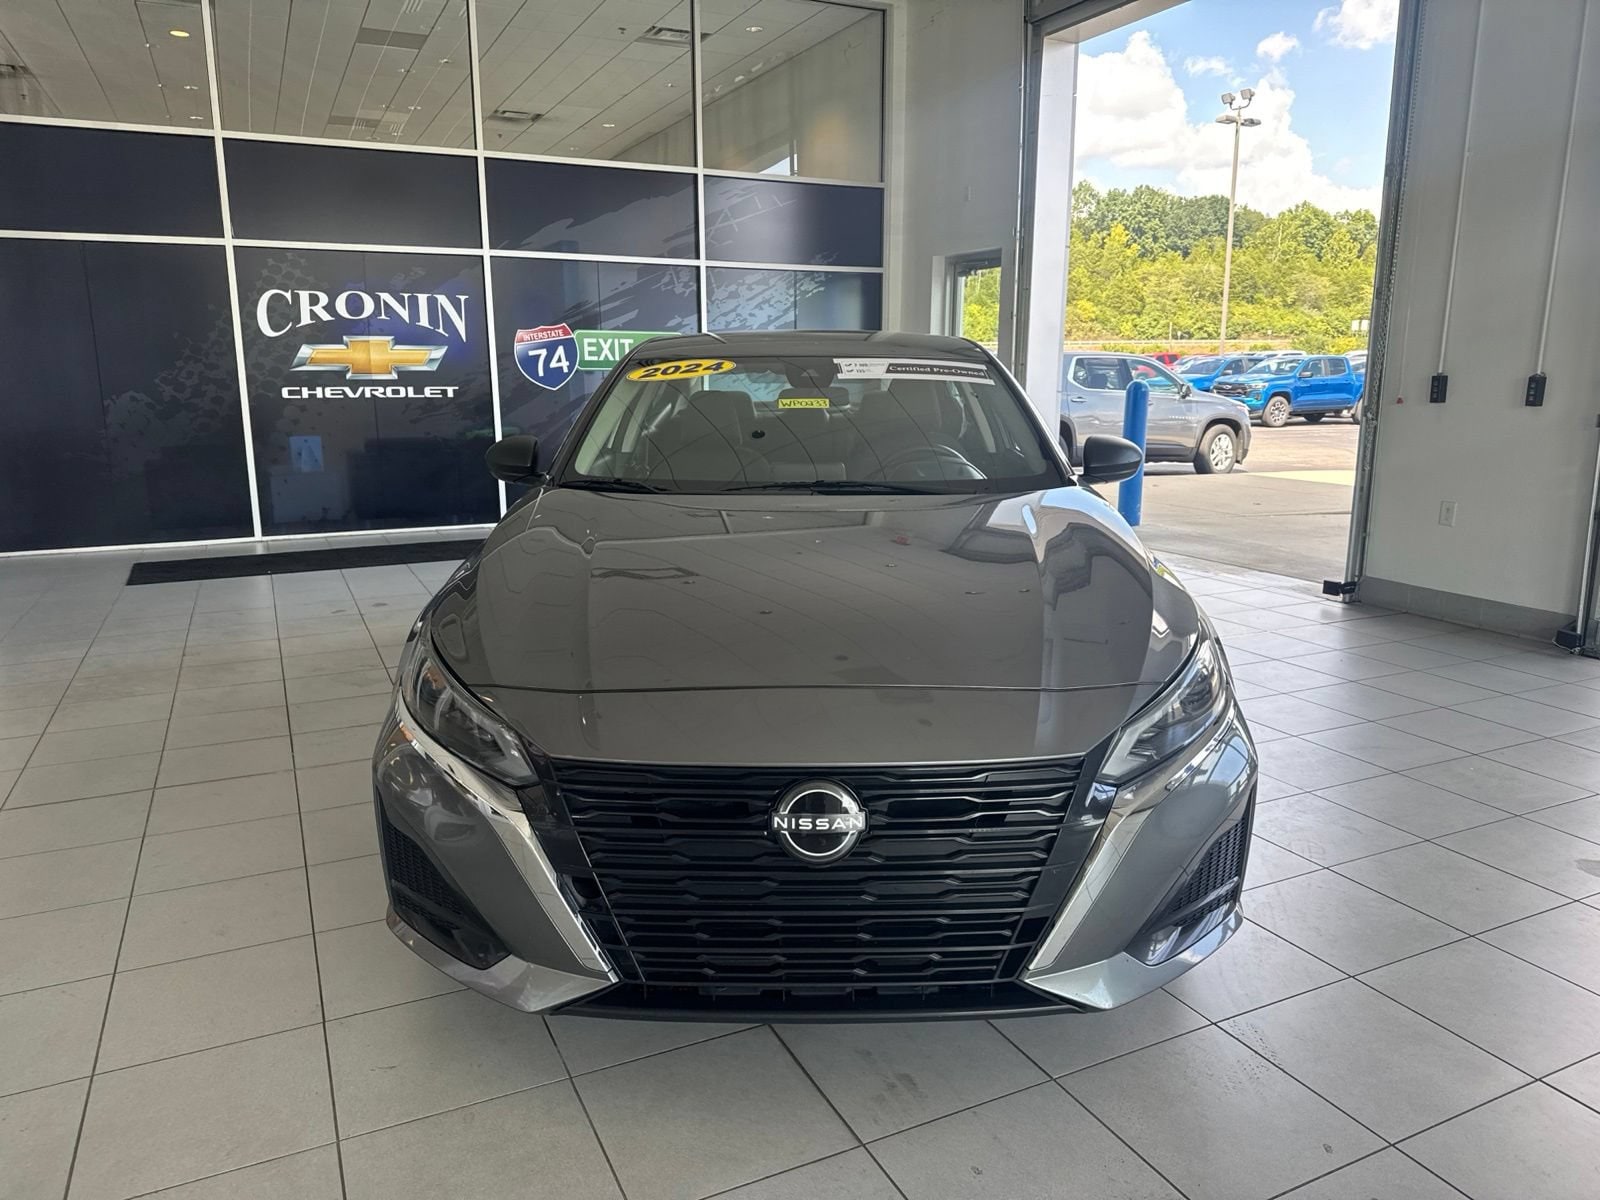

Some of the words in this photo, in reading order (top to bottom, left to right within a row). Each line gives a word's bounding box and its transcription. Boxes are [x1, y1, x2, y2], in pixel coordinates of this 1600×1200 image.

[256, 288, 469, 343] CRONIN
[523, 330, 565, 341] INTERSTATE
[583, 337, 634, 361] EXIT
[528, 345, 570, 377] 74
[638, 361, 724, 379] 2024
[889, 365, 931, 373] Certified
[933, 366, 985, 377] Pre-Owned
[281, 386, 459, 399] CHEVROLET
[773, 816, 863, 830] NISSAN
